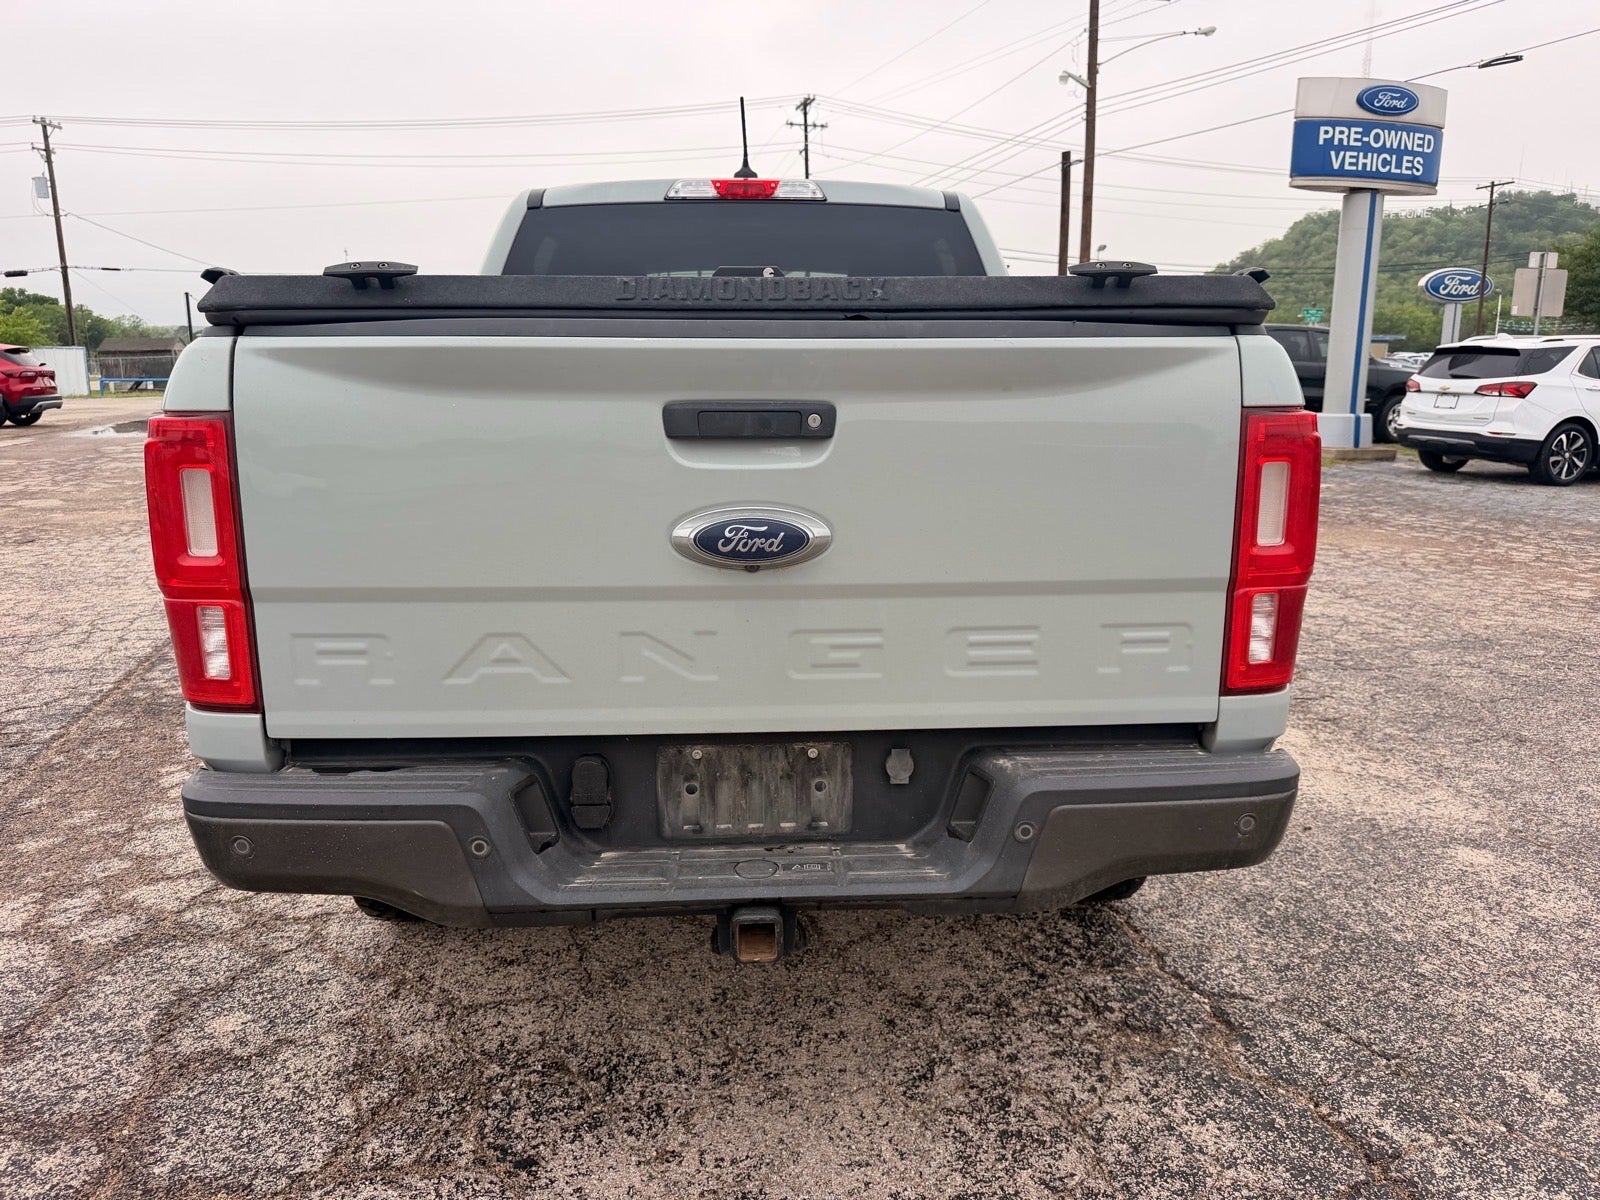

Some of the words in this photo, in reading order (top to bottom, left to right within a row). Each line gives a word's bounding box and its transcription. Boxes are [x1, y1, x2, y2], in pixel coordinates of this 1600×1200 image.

[1374, 91, 1408, 109] Ford
[1318, 126, 1434, 153] PRE-OWNED
[1330, 151, 1423, 176] VEHICLES
[615, 276, 889, 301] DIAMONDBACK
[1439, 275, 1481, 295] Ford
[717, 524, 785, 552] Ford
[290, 622, 1194, 686] RANGER
